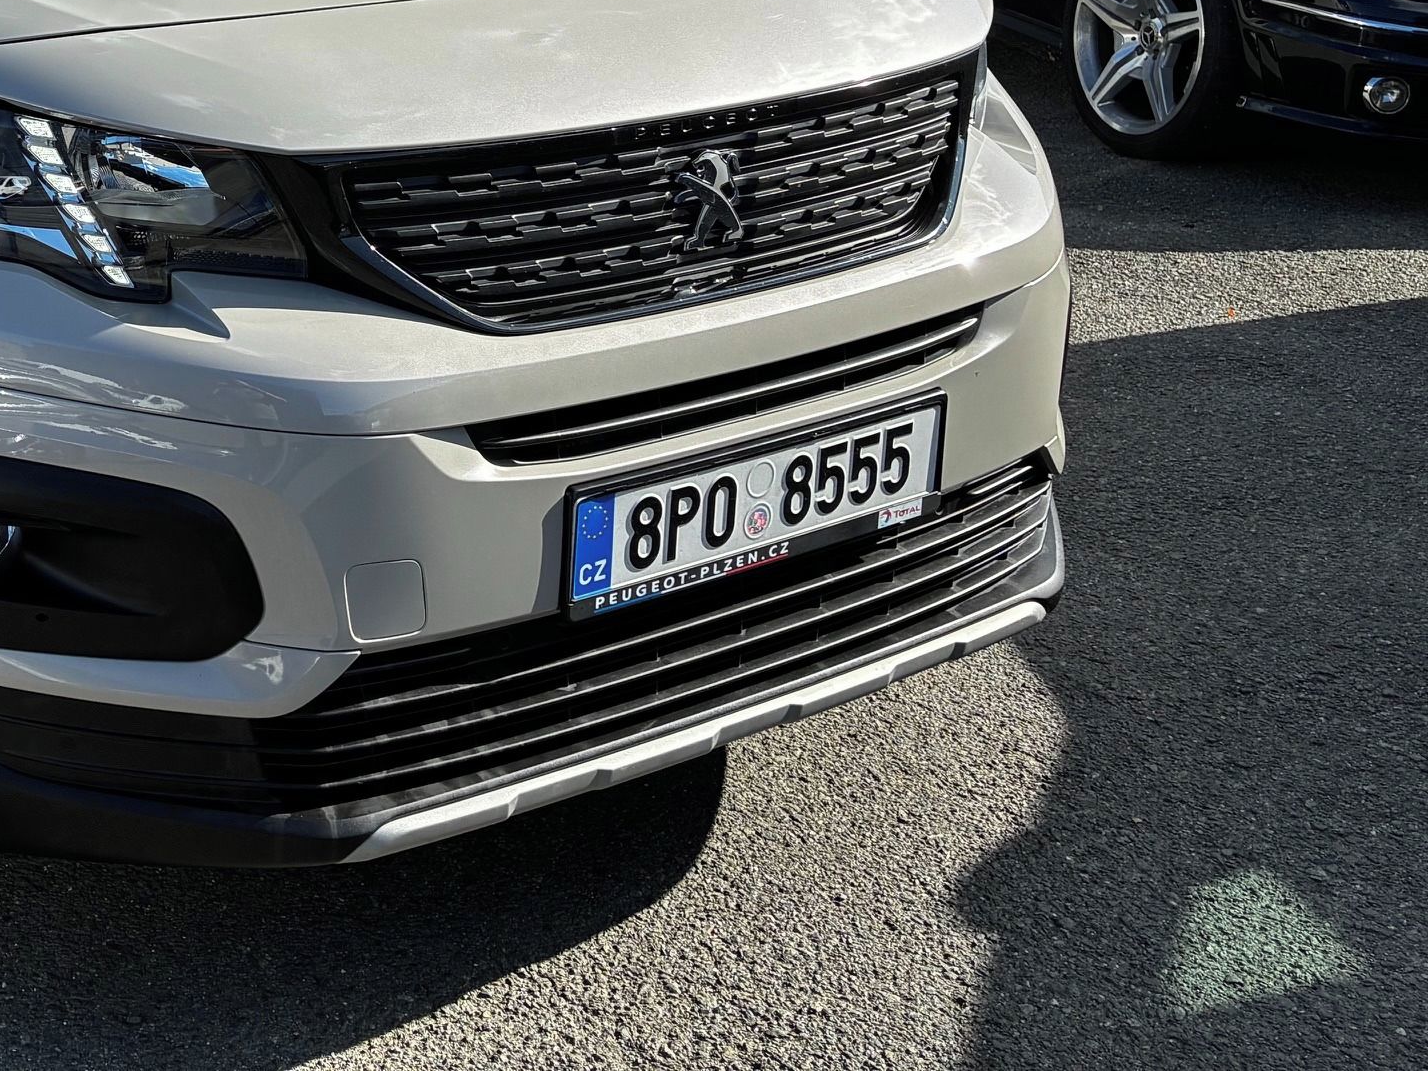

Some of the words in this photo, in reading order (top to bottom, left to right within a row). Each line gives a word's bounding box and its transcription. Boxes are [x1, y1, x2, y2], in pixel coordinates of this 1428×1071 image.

[635, 104, 779, 140] PEUGEOT
[783, 420, 915, 526] 8555
[894, 504, 921, 519] TOTAL
[578, 558, 607, 586] CZ
[594, 541, 790, 610] PEUGEOT-PLZEN.CZ
